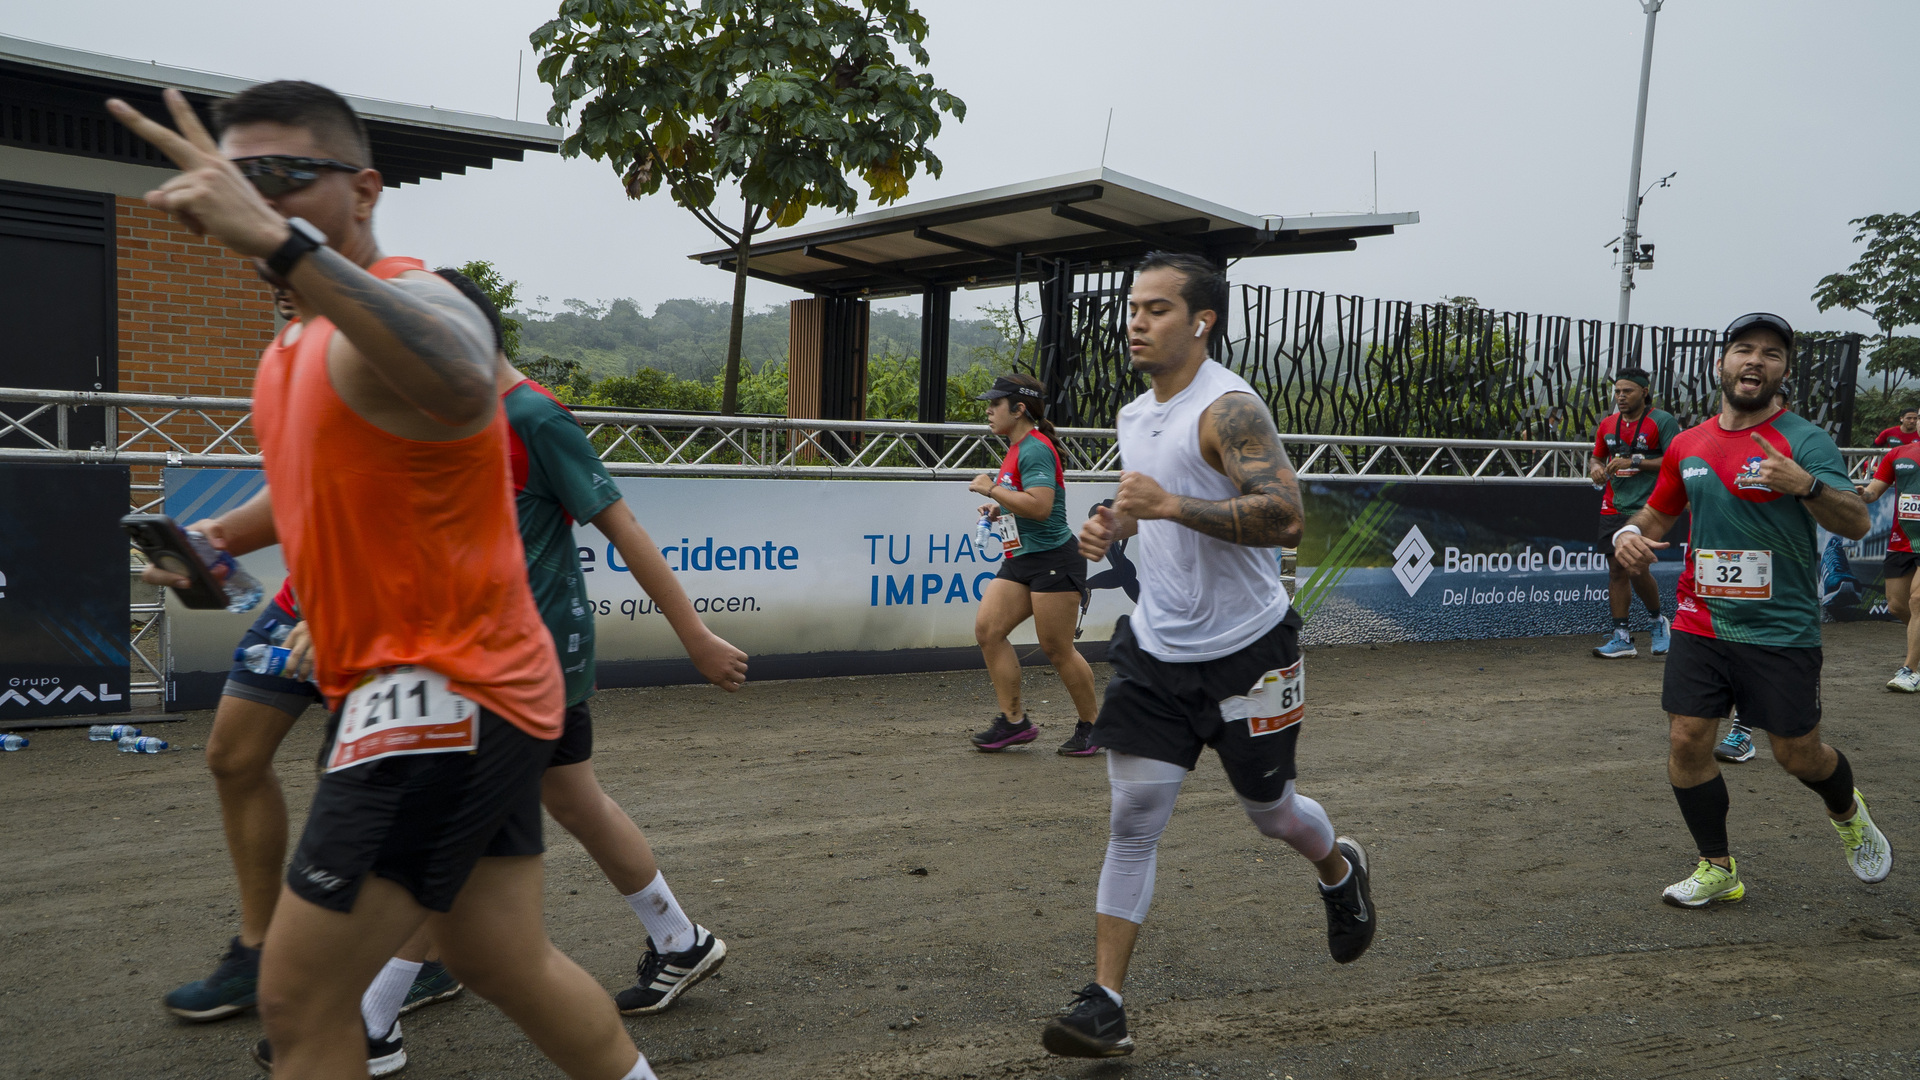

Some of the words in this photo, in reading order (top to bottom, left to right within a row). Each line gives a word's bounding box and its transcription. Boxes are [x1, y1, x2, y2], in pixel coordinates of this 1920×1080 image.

[607, 537, 799, 572] Ocidente
[864, 534, 911, 565] TU
[1444, 546, 1512, 573] Banco
[1517, 546, 1543, 572] de
[1548, 545, 1609, 571] Occid
[1716, 565, 1742, 583] 32
[689, 596, 761, 613] acen.
[1442, 587, 1468, 606] Del
[1471, 587, 1504, 604] lado
[1507, 586, 1525, 603] de
[1529, 585, 1550, 602] los
[1553, 589, 1580, 605] que
[0, 683, 122, 707] AVAL
[9, 677, 60, 687] Grupo
[1282, 681, 1301, 709] 81
[362, 680, 429, 729] 211
